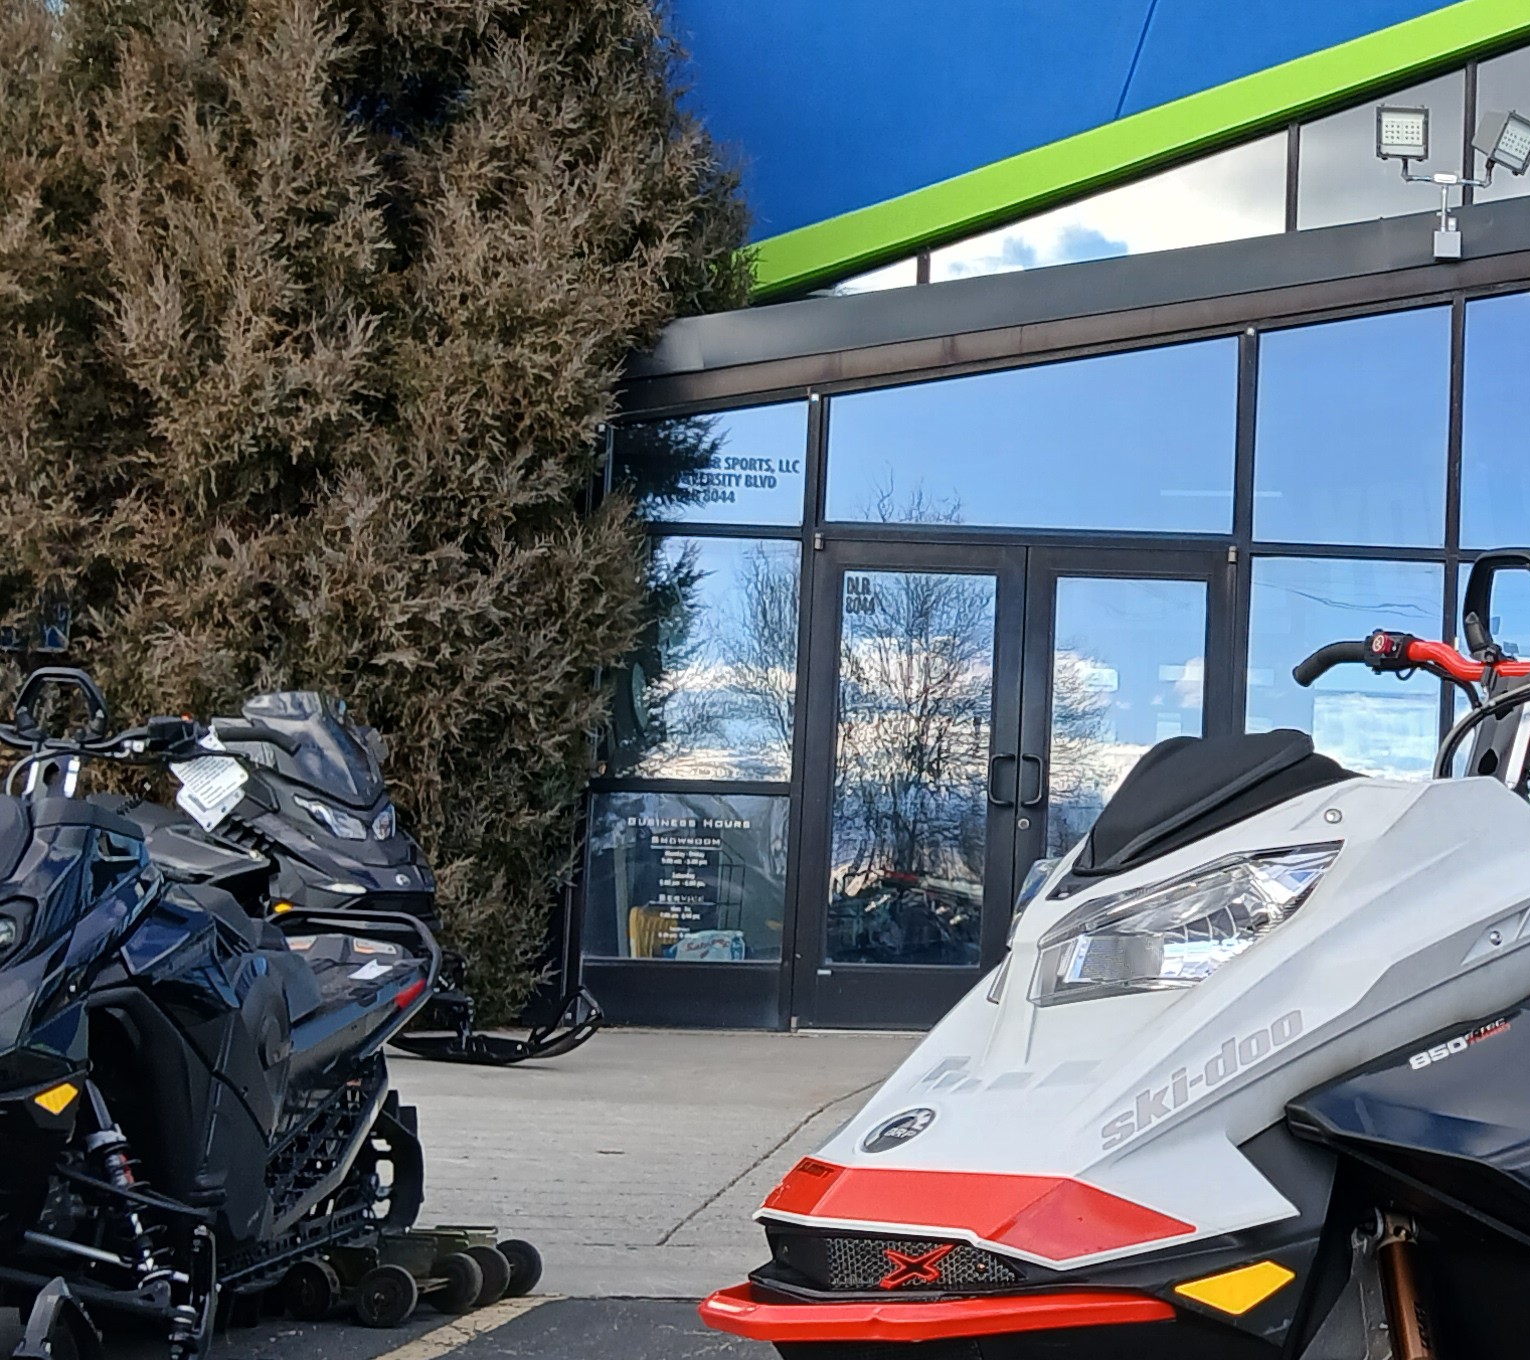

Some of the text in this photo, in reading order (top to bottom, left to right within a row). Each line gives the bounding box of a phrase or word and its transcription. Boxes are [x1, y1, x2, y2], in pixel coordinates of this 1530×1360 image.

[778, 458, 801, 474] LLC
[744, 474, 778, 489] BLVD
[702, 818, 752, 830] HOURS
[1408, 1035, 1469, 1070] 850
